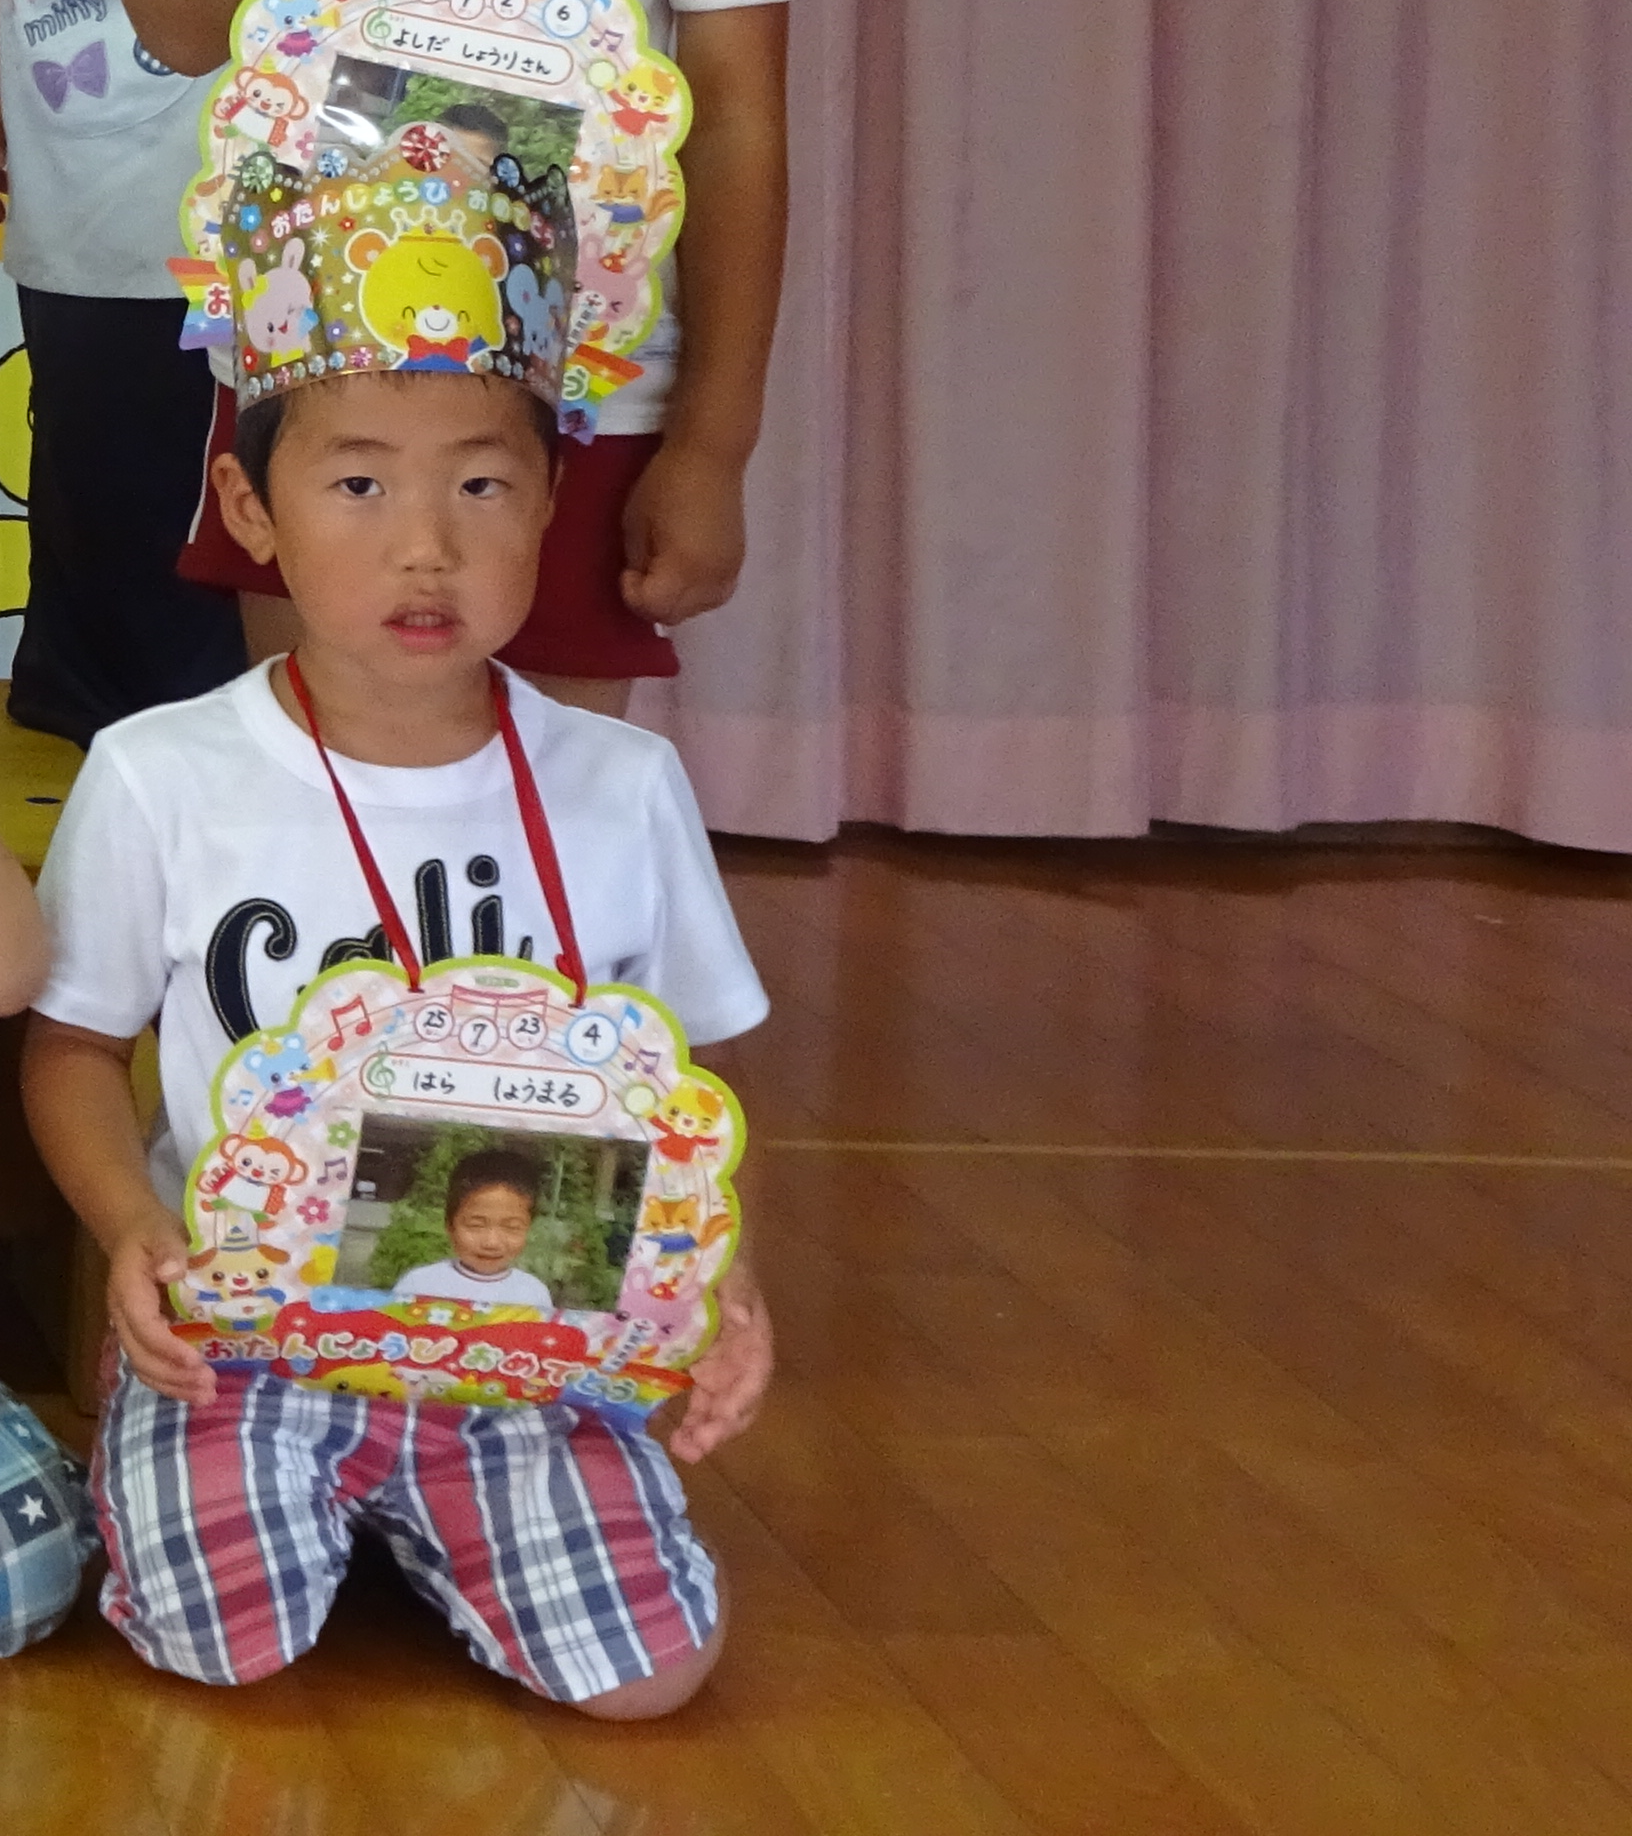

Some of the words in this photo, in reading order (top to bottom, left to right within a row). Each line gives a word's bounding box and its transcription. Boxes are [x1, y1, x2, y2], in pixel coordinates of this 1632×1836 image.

[556, 5, 570, 21] 6
[393, 29, 450, 52] よしだ
[423, 1010, 447, 1028] 25
[472, 1023, 487, 1046] 7
[516, 1017, 541, 1034] 23
[582, 1023, 602, 1046] 4
[413, 1072, 456, 1094] はら
[494, 1076, 581, 1107] しょうまる
[201, 1328, 460, 1365] おたんじょうび
[458, 1338, 637, 1404] おめでとう
